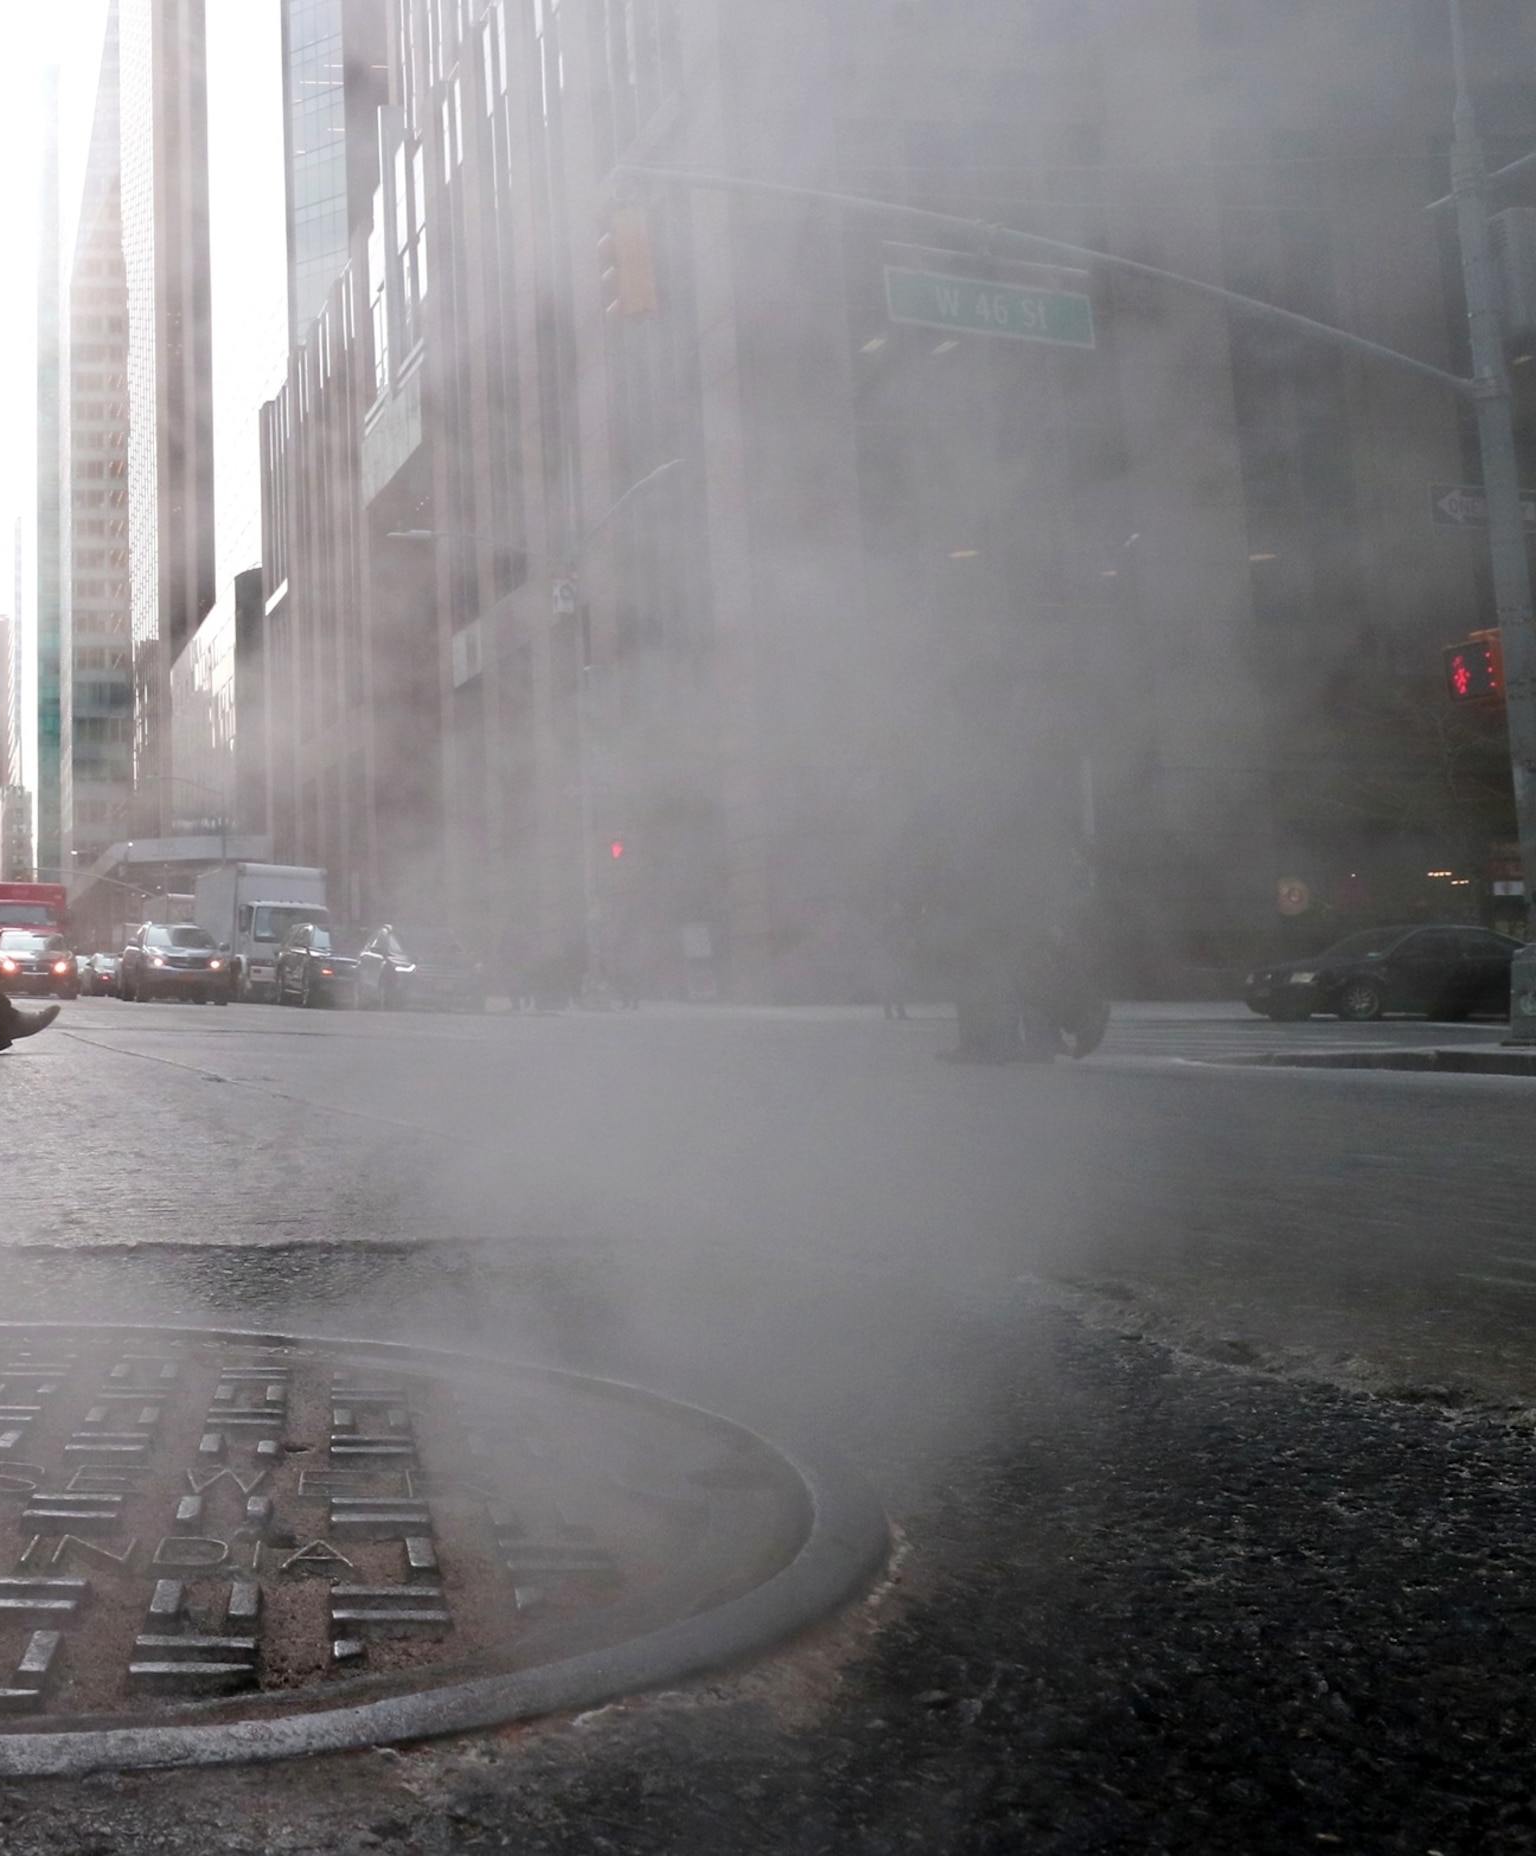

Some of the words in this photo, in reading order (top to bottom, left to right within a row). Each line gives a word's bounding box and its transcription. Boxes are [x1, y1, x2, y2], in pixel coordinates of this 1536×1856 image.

[935, 285, 960, 317] W
[974, 292, 1009, 325] 46
[1020, 298, 1048, 331] St
[1448, 496, 1478, 514] ONE
[19, 1533, 355, 1570] INDIA
